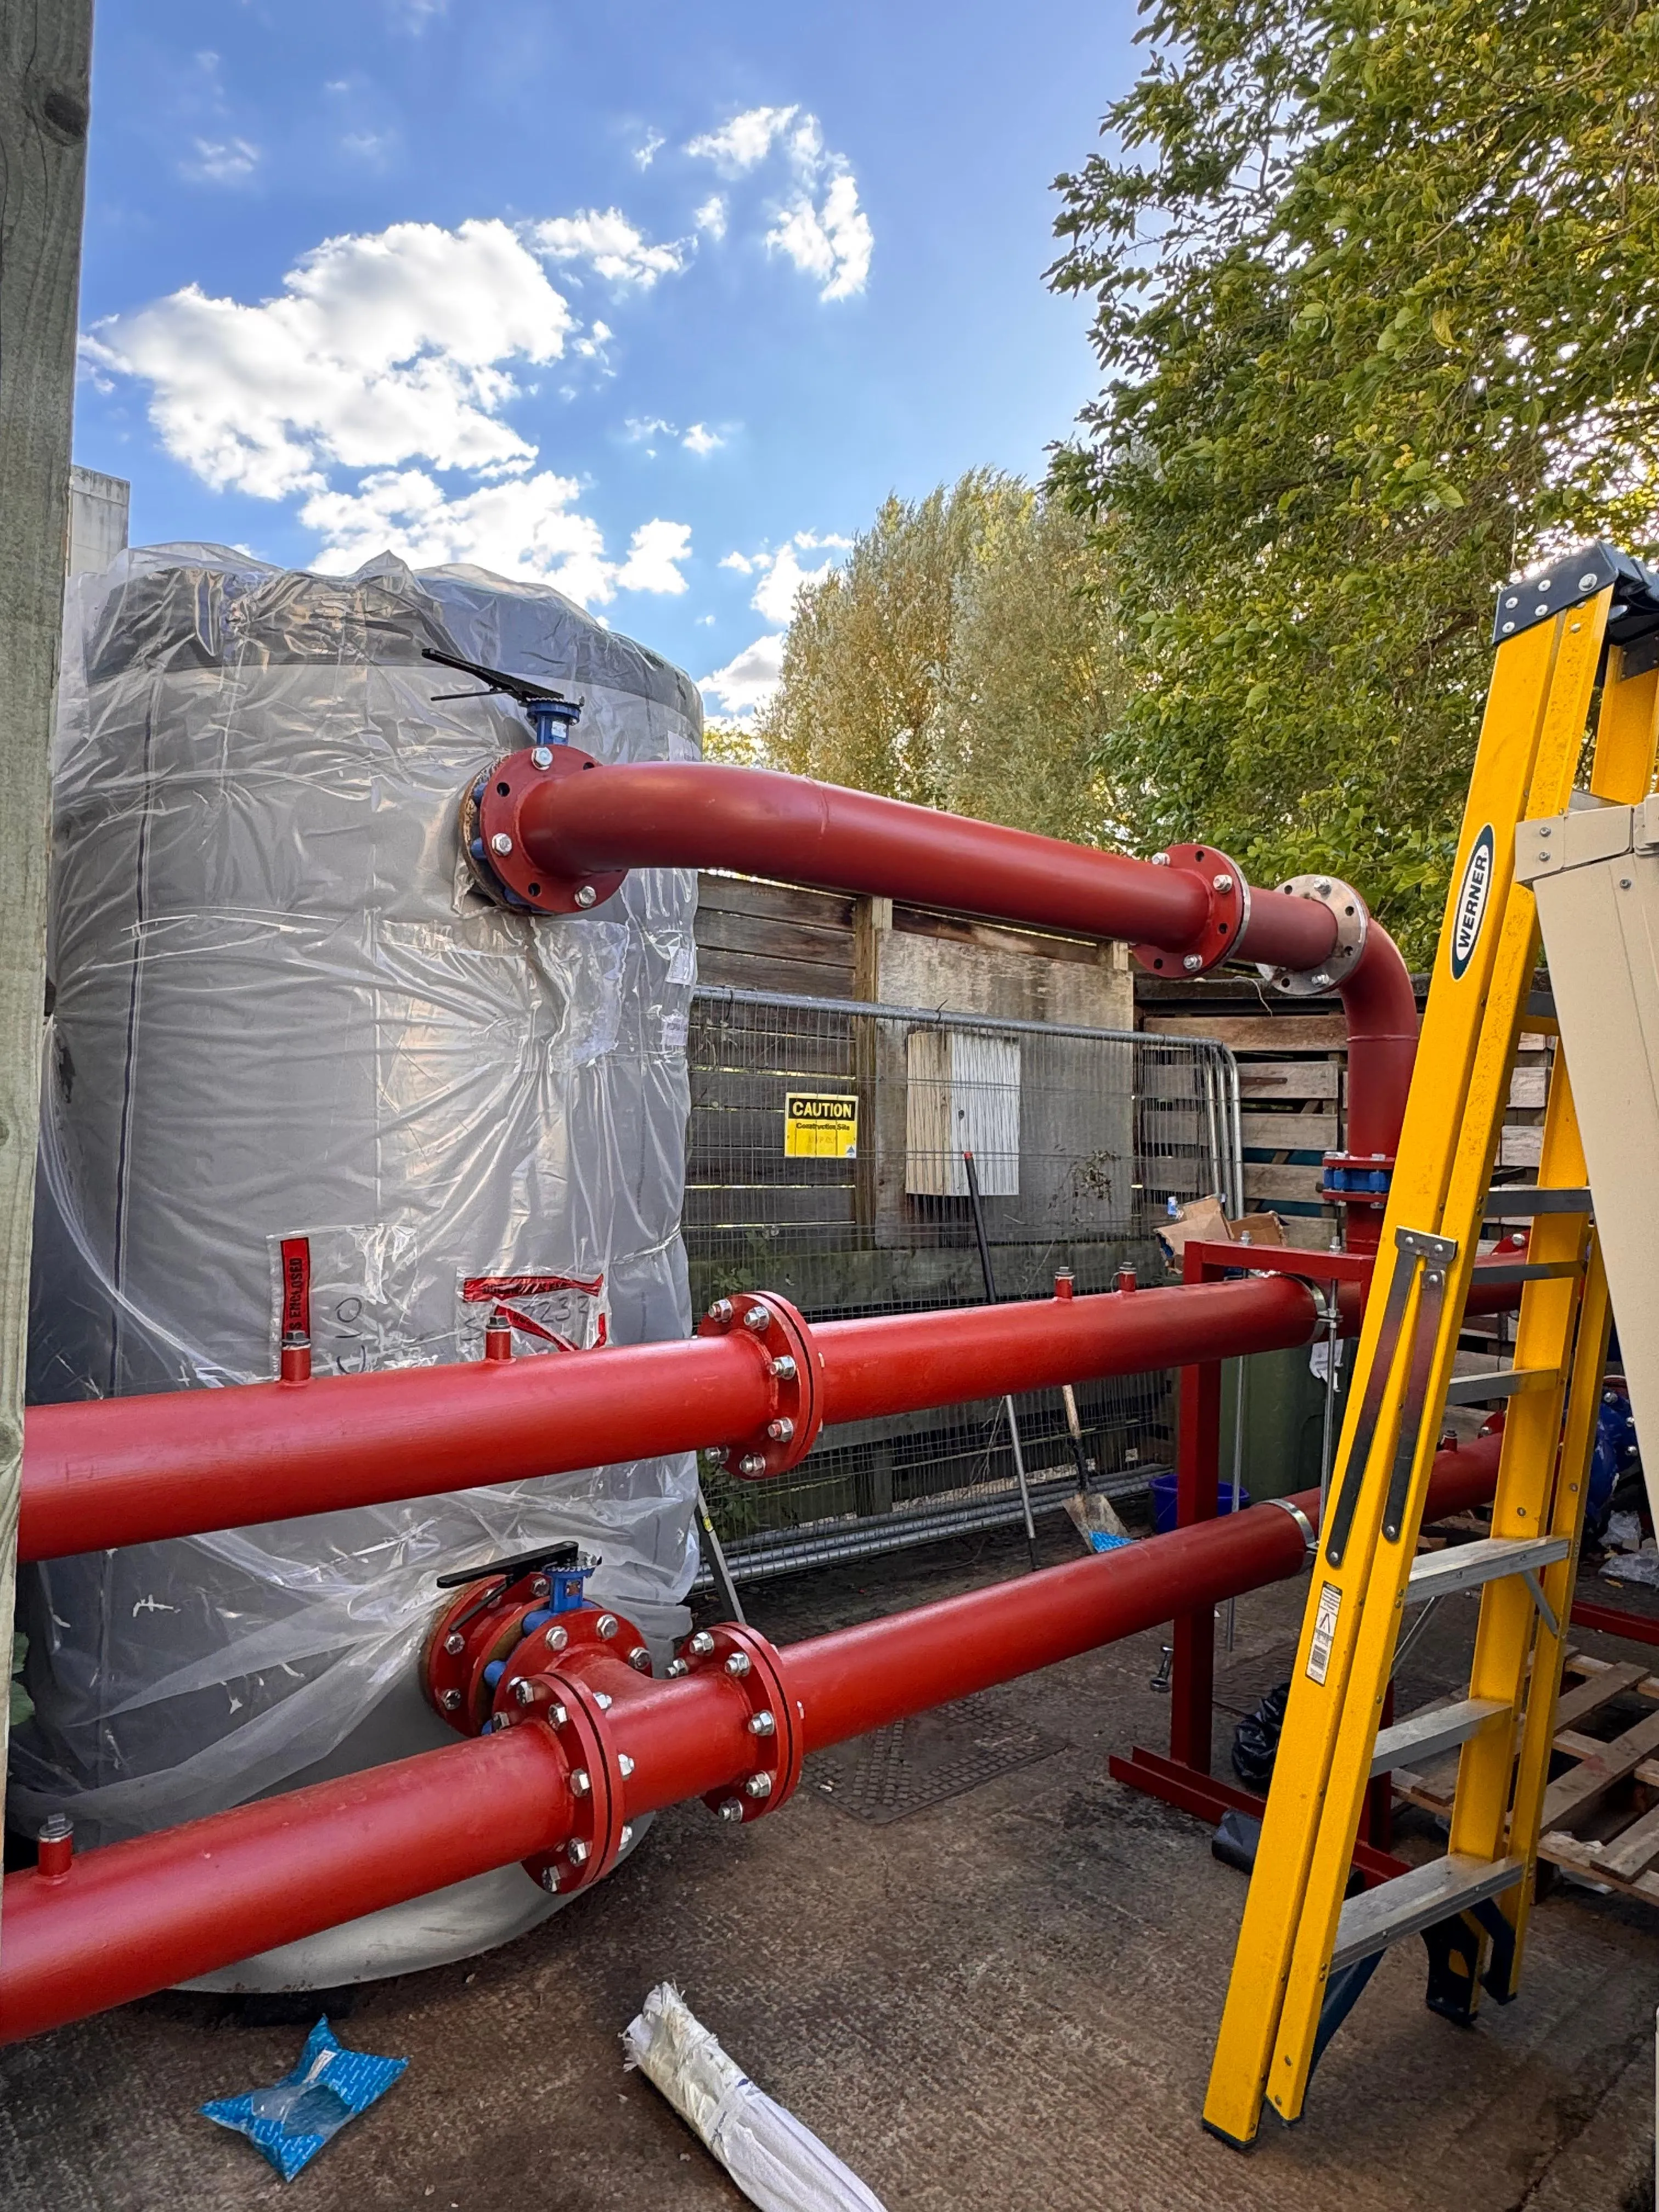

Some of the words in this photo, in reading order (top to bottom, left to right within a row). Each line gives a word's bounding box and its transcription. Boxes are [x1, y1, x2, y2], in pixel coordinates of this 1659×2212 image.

[1458, 855, 1487, 948] WERNER
[792, 1101, 852, 1118] CAUTION
[289, 1257, 302, 1318] ENCLOSED
